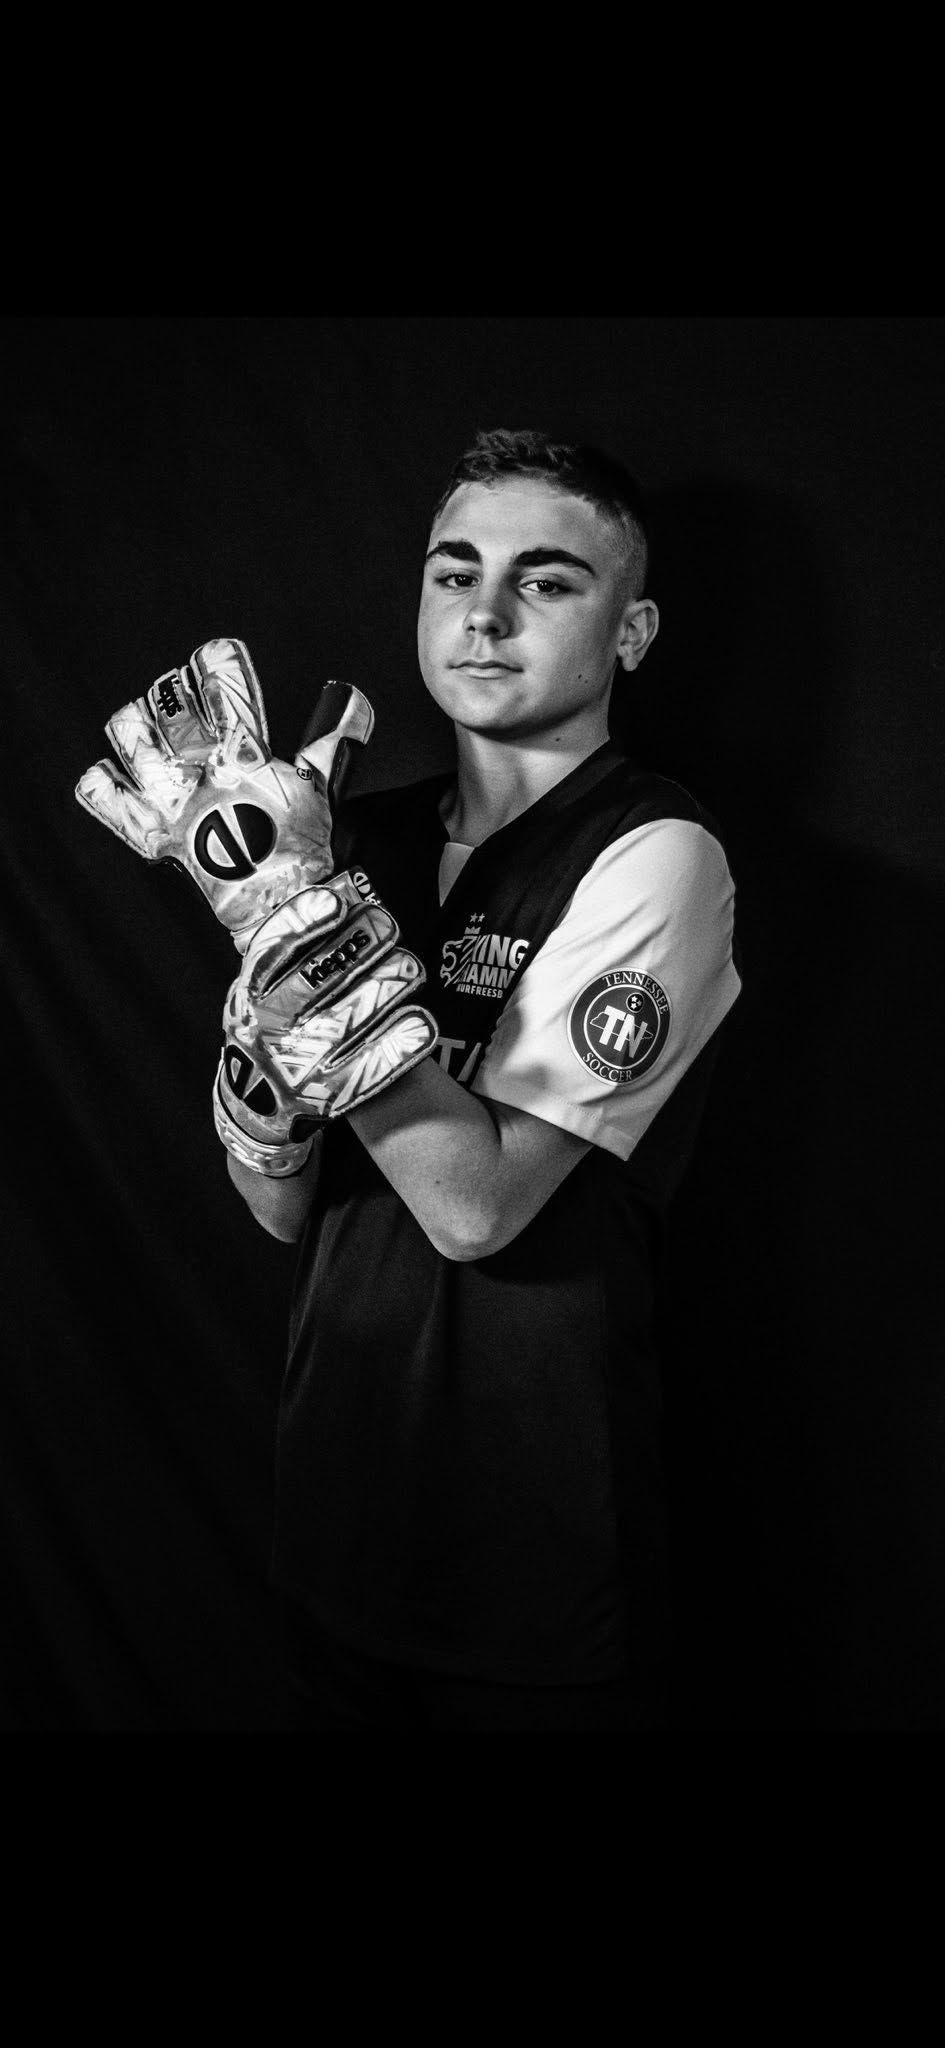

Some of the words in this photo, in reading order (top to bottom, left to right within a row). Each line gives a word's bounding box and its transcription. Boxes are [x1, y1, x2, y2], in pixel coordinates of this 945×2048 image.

[602, 971, 669, 1015] TENNESSEE
[599, 1004, 649, 1059] TN
[582, 1052, 632, 1082] SOCCER
